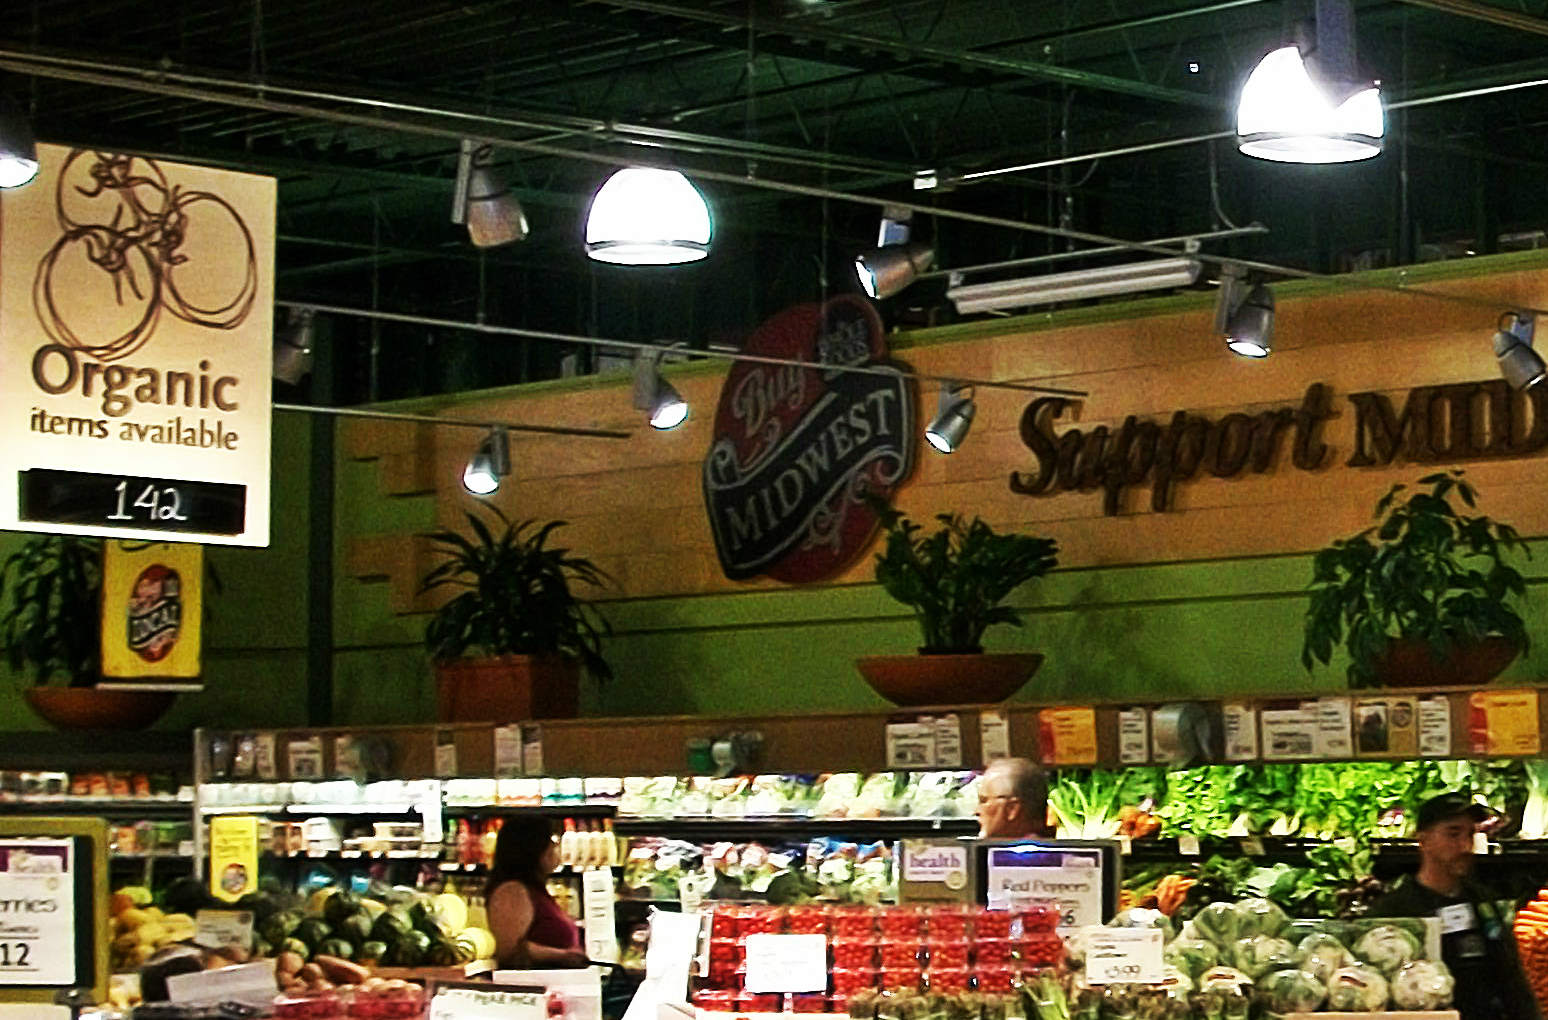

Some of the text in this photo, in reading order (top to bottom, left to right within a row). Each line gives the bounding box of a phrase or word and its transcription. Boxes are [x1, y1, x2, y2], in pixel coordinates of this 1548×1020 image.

[31, 343, 240, 417] Organic
[30, 406, 239, 451] items available
[1009, 382, 1342, 517] Support
[725, 388, 897, 551] MIDWEST
[107, 480, 189, 522] 142
[909, 853, 962, 868] health
[1002, 878, 1092, 894] Red Peppers
